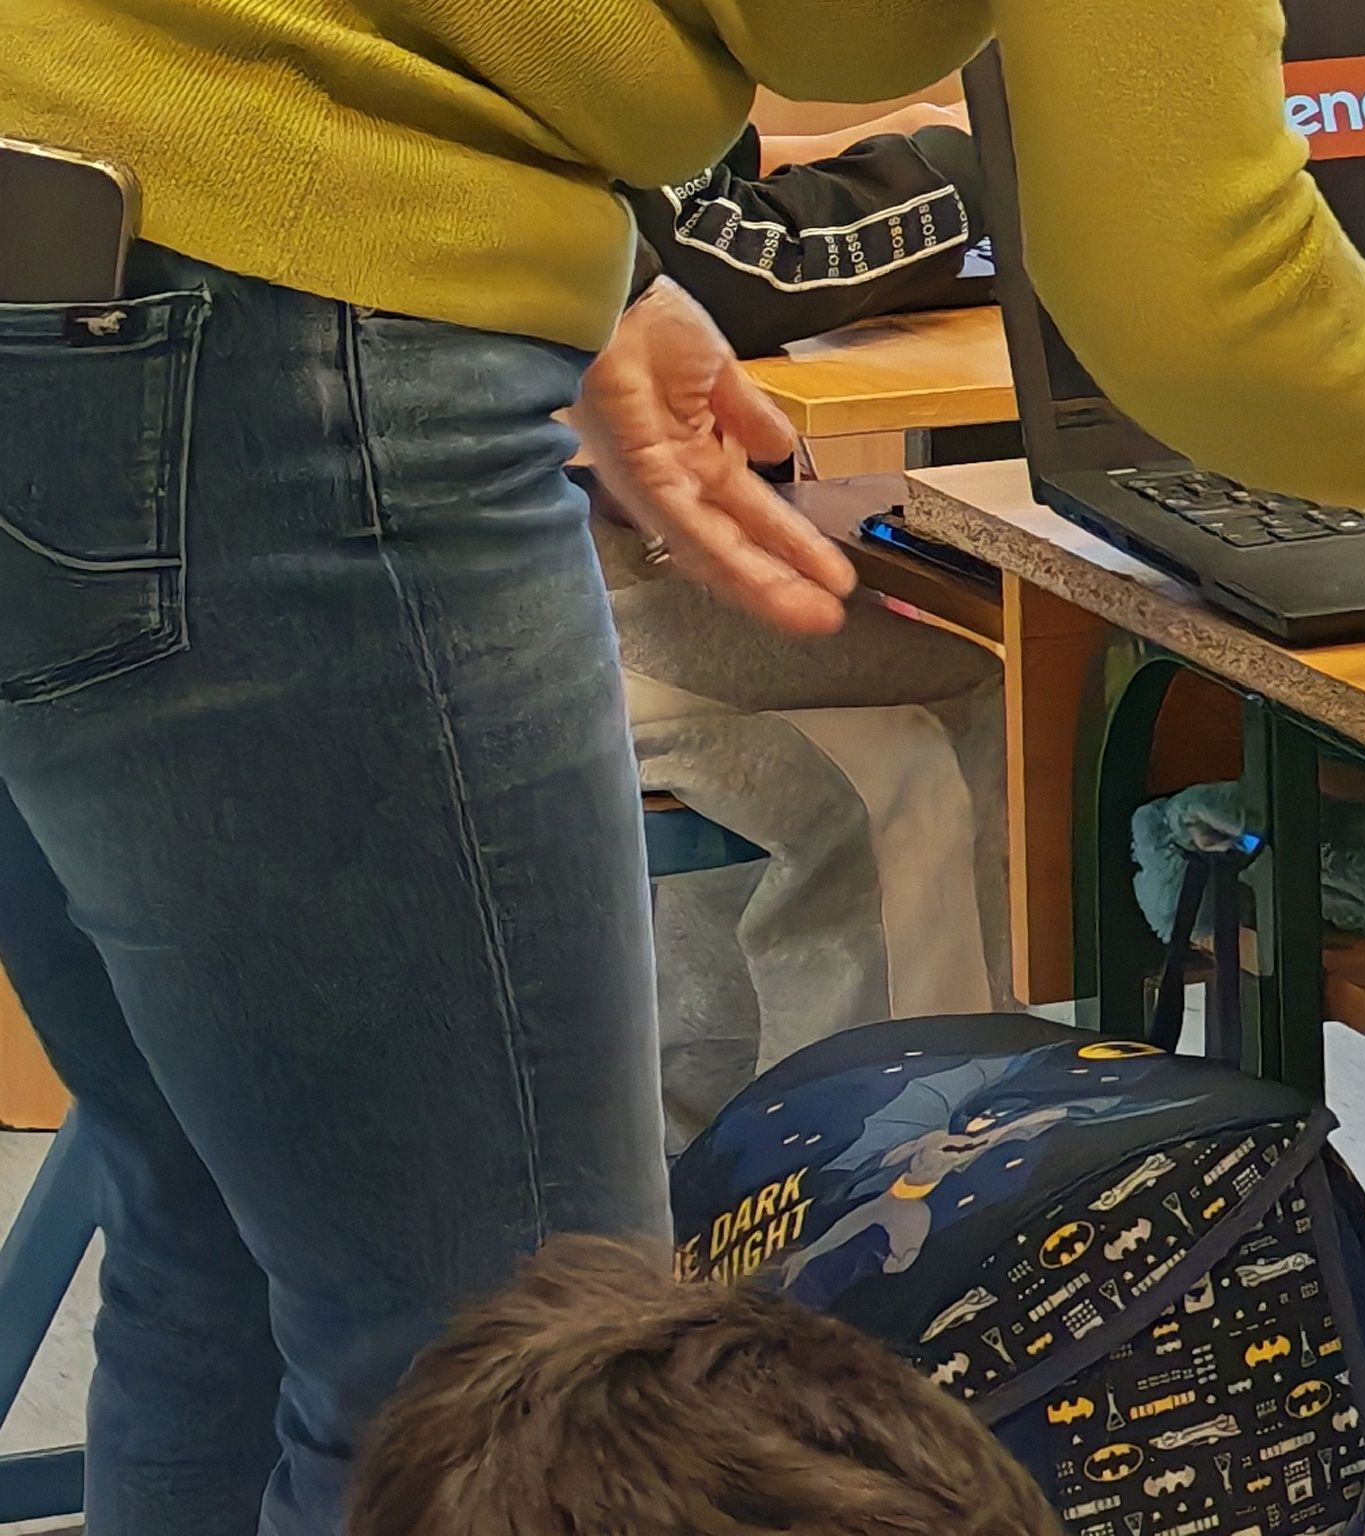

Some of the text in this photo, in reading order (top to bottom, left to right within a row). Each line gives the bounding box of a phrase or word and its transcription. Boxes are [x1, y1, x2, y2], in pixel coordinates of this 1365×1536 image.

[715, 212, 742, 250] BOSS
[887, 215, 906, 260] BOSS
[918, 203, 938, 248] BOSS
[758, 228, 782, 270] BOSS
[845, 232, 869, 275] BOSS
[709, 1166, 809, 1261] DARK
[704, 1197, 816, 1288] NIGHT
